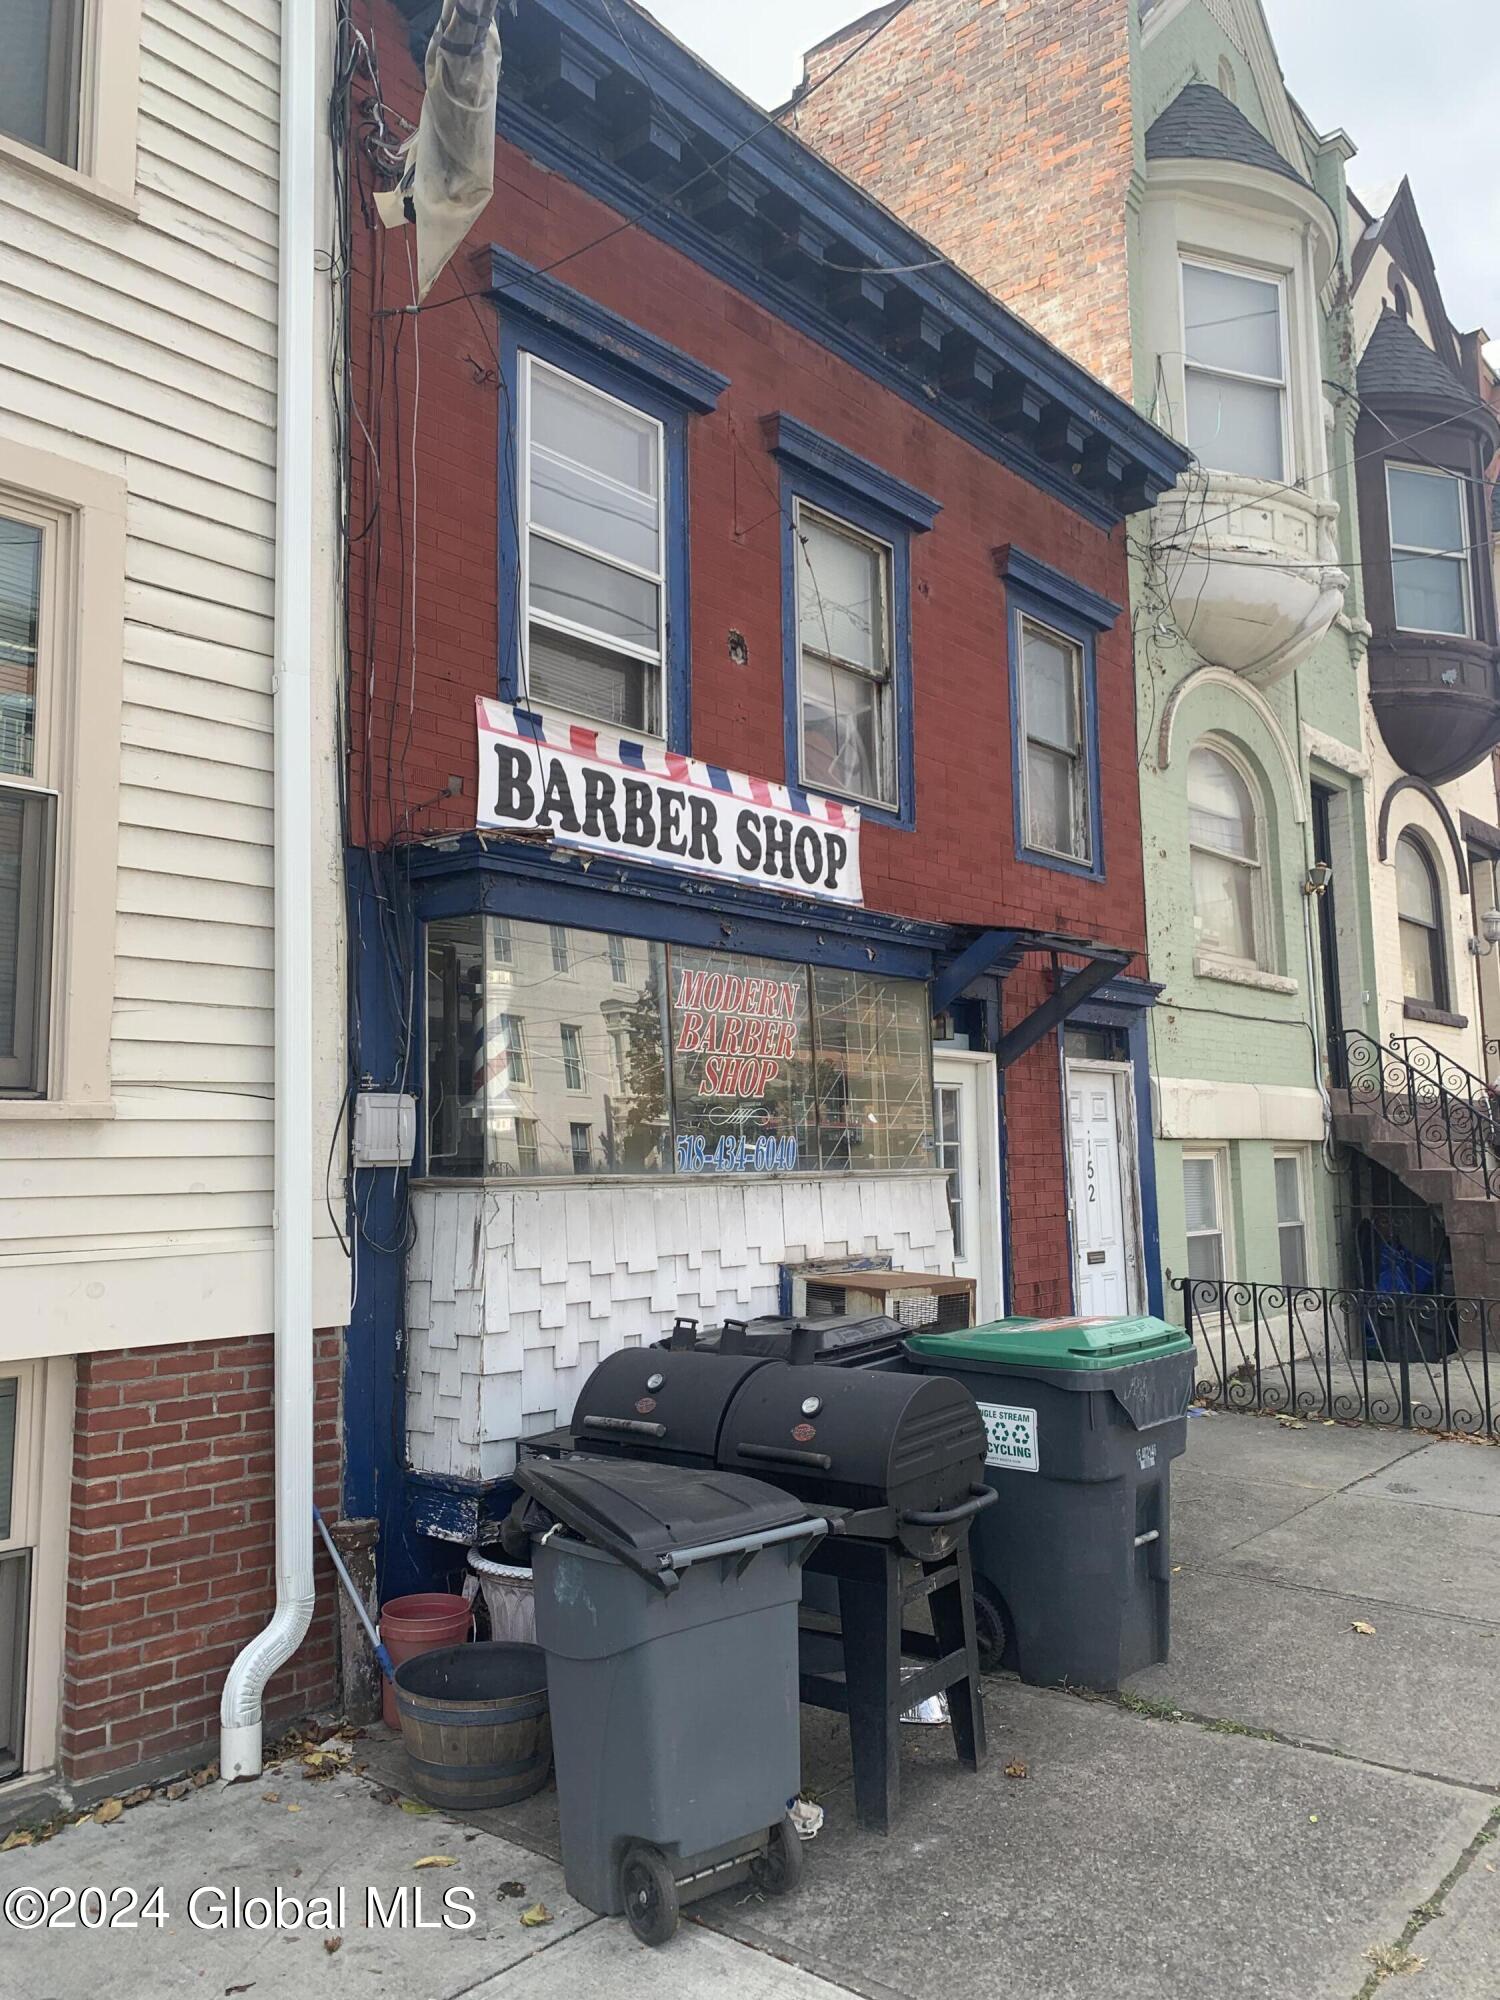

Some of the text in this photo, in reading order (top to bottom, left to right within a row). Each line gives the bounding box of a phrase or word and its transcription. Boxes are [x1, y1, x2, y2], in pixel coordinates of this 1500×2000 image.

[494, 743, 847, 889] BARBER SHOP
[675, 969, 800, 1020] MODERN
[676, 1011, 797, 1059] BARBER
[699, 1056, 778, 1097] SHOP
[676, 1135, 797, 1172] 518-434-6040
[999, 1411, 1030, 1423] STREAM
[986, 1442, 1032, 1459] CYCLING
